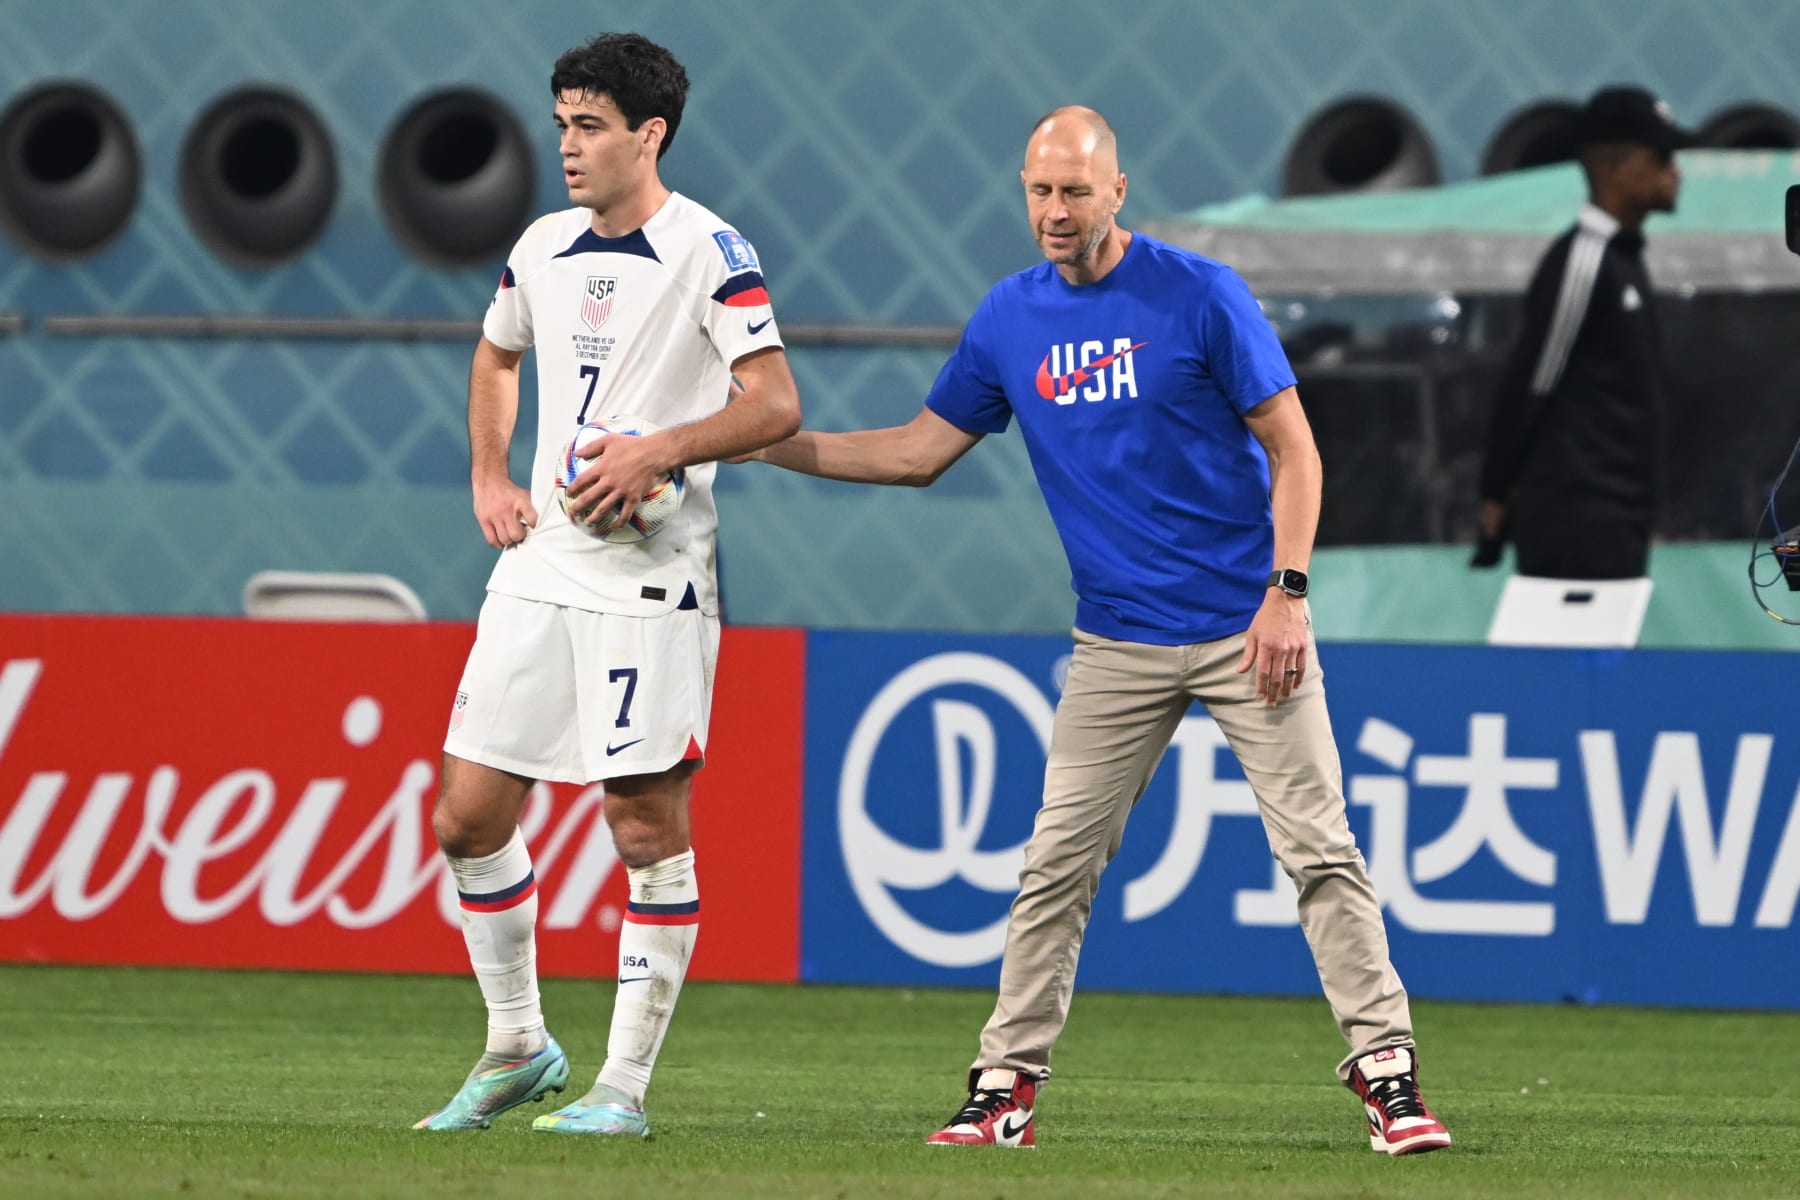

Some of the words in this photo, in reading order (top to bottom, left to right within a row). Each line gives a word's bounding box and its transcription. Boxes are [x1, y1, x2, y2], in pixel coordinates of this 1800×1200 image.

[588, 279, 615, 300] USA
[577, 364, 601, 425] 7
[1051, 337, 1139, 406] USA
[609, 667, 638, 728] 7
[623, 954, 649, 968] USA
